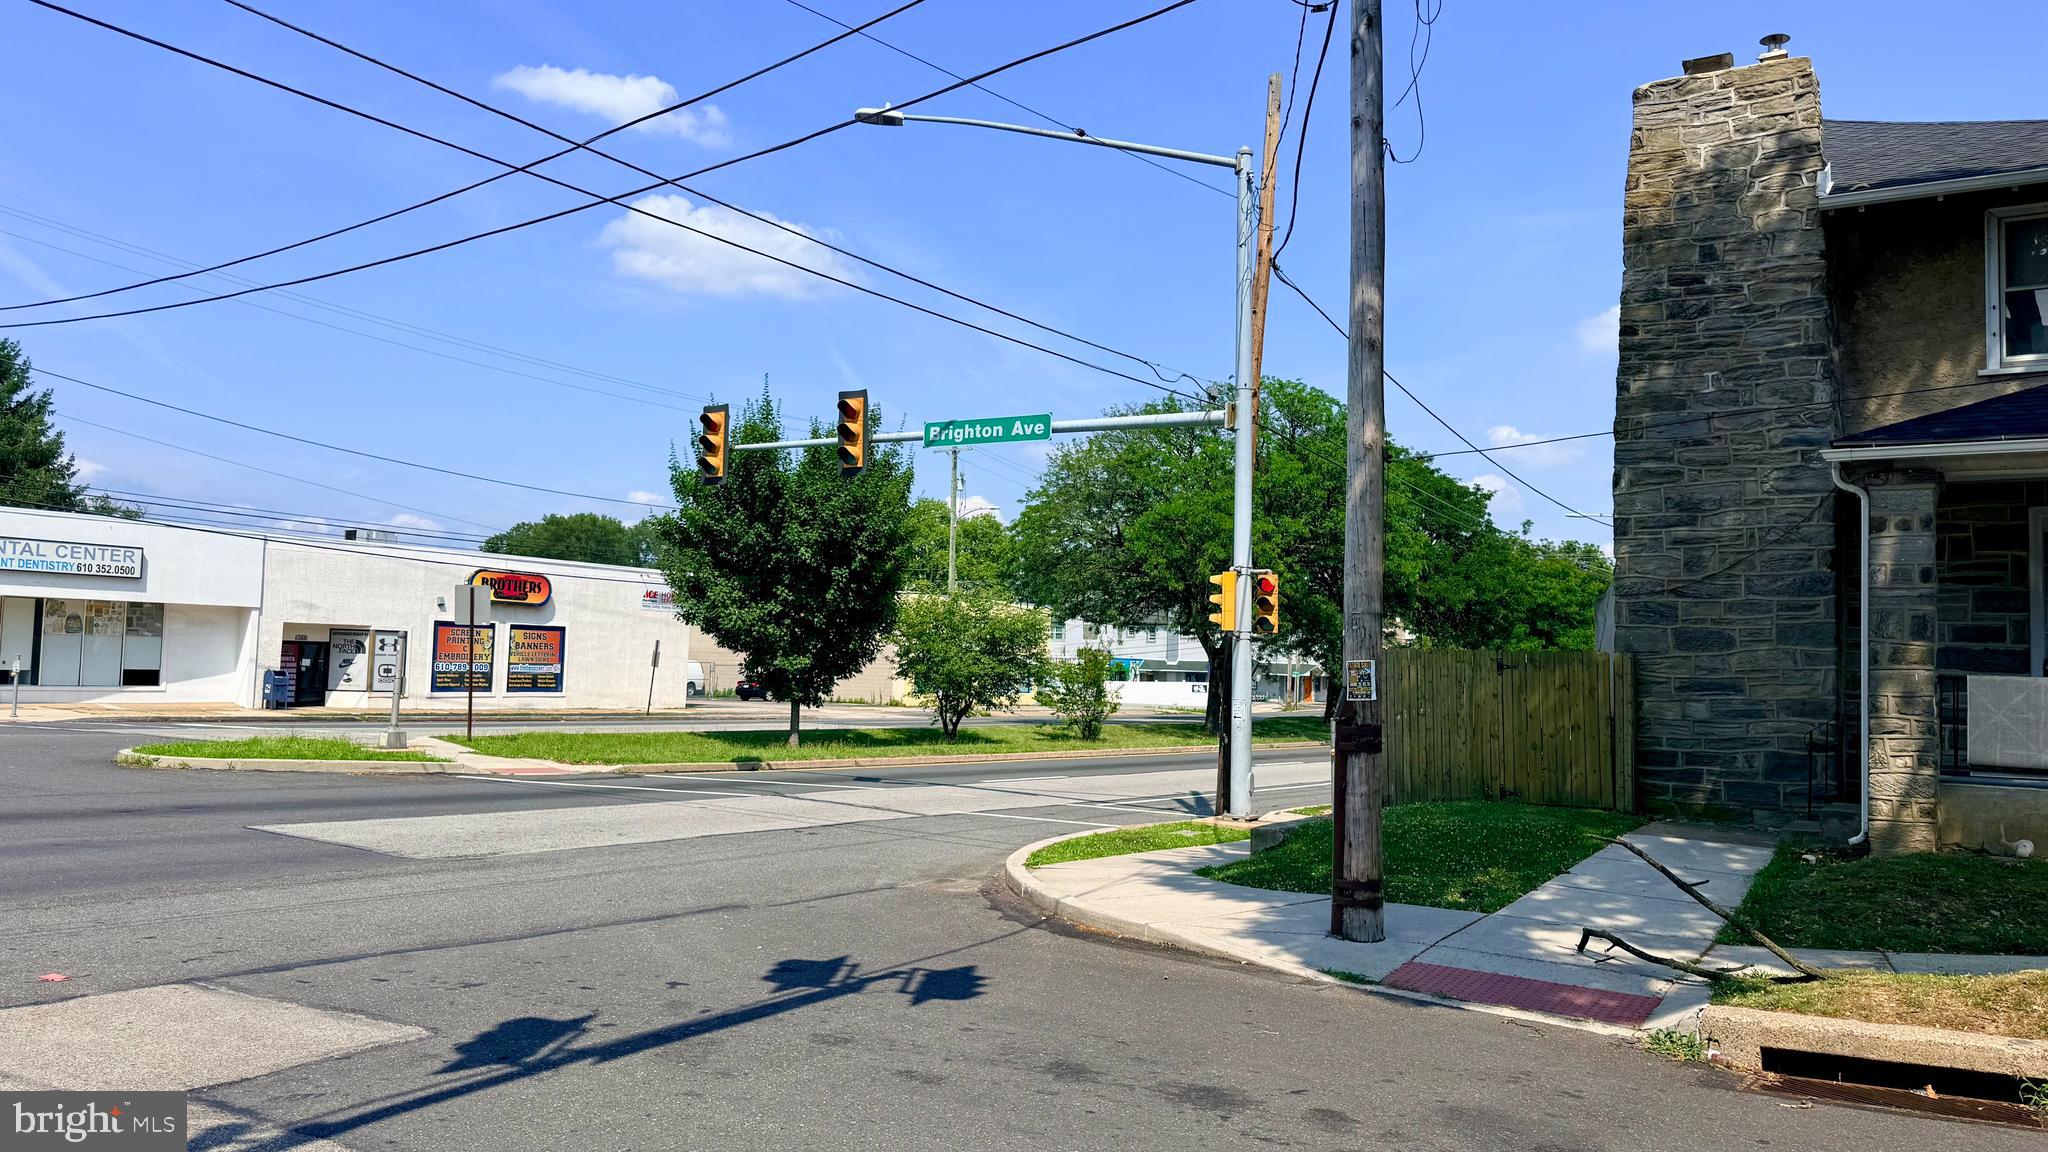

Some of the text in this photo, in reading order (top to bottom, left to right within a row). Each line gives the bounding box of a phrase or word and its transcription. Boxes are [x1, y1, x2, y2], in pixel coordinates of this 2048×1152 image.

[929, 420, 1045, 442] Brighton Ave
[55, 545, 136, 564] CENTER
[17, 558, 75, 572] DENTISTRY
[76, 562, 93, 573] 610
[95, 564, 136, 576] 352.0500
[481, 577, 542, 594] BROTHERS
[450, 629, 482, 637] SCREN
[523, 632, 548, 640] SIGNS
[446, 637, 485, 645] PRINTNG
[515, 642, 554, 650] BANNERS
[438, 653, 491, 661] EMBROIERY
[434, 663, 490, 672] 610-789-009
